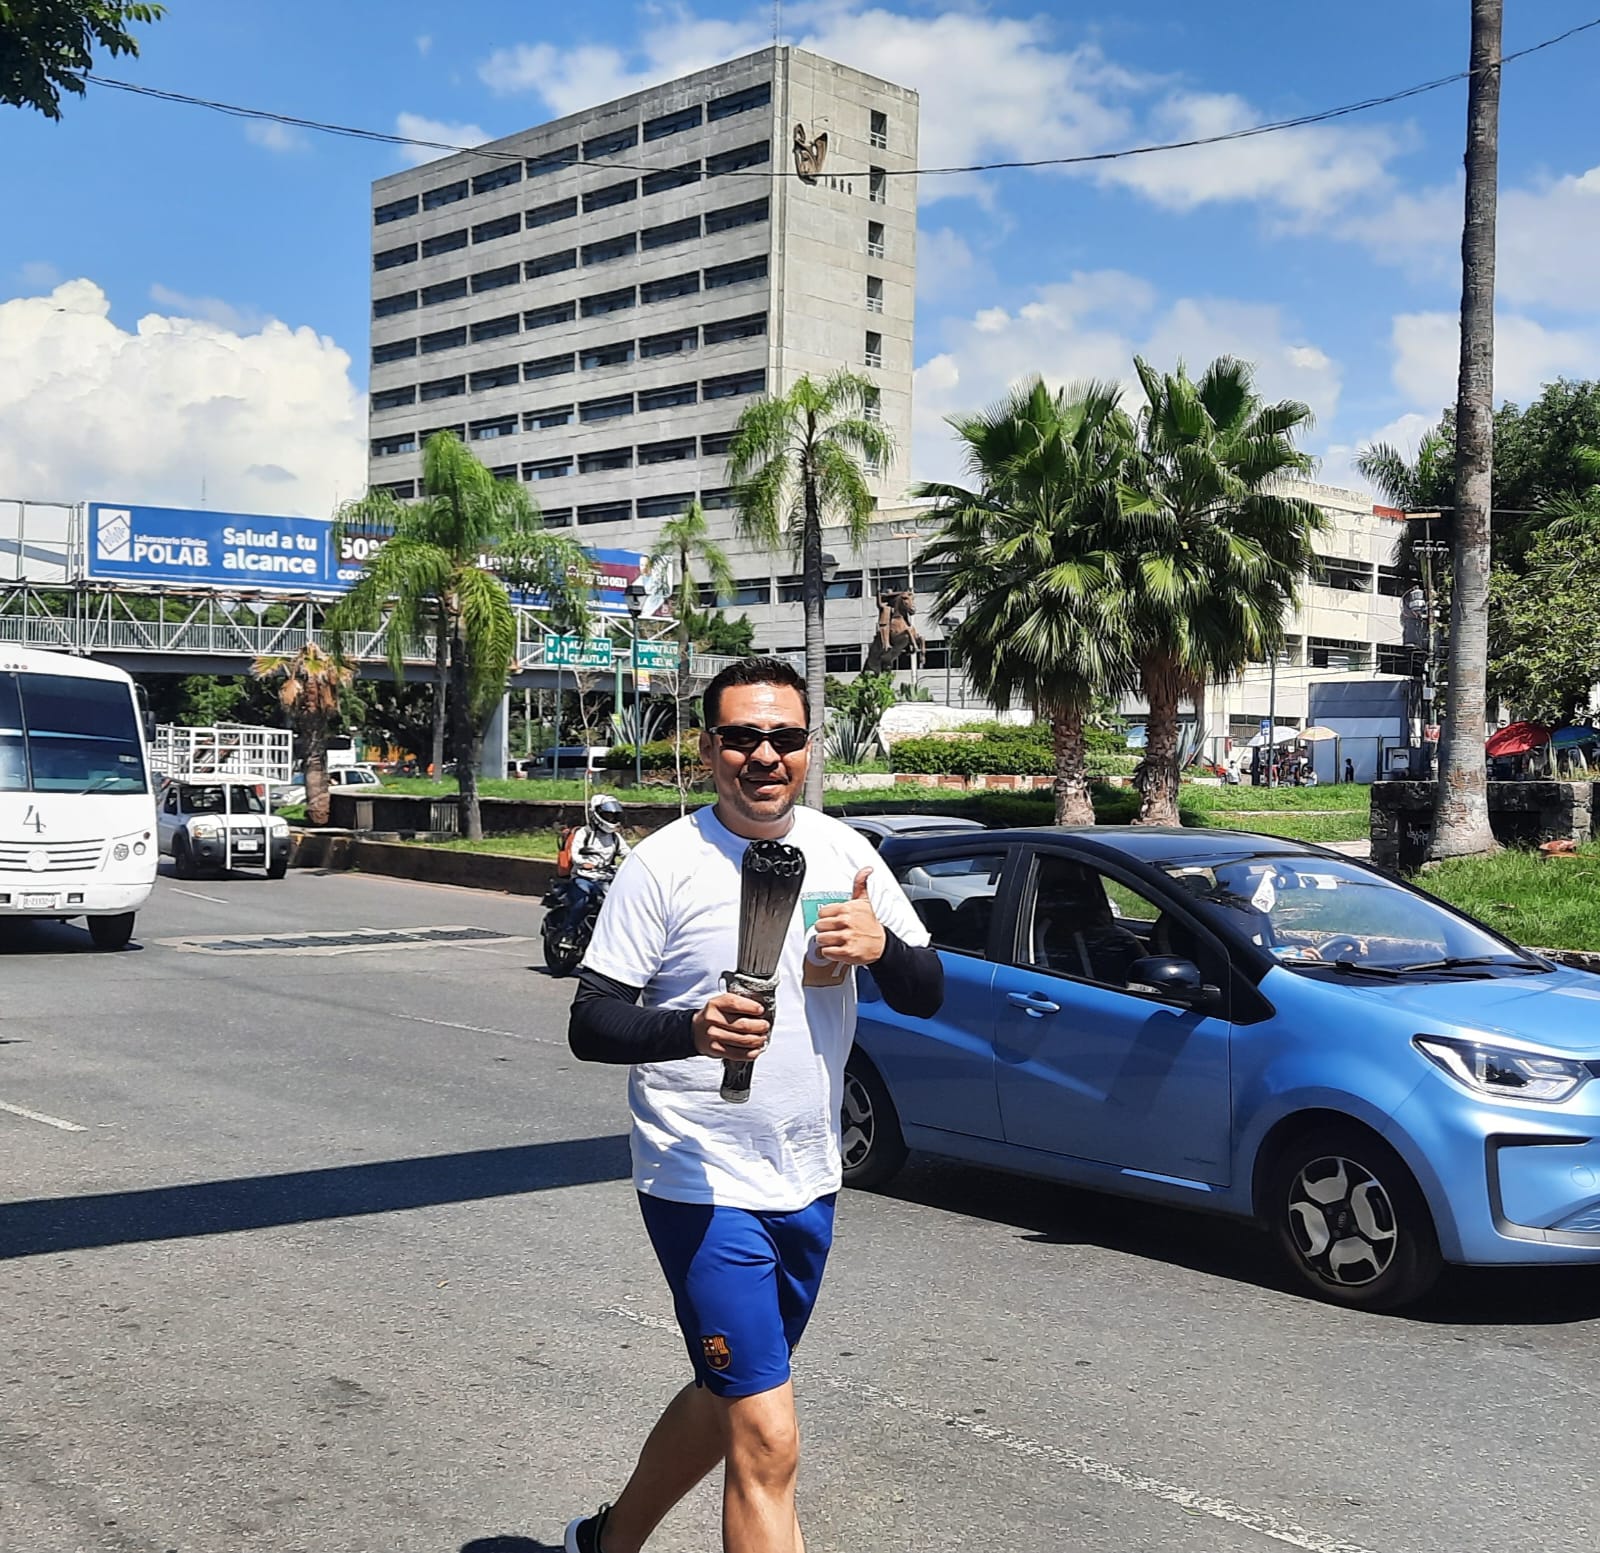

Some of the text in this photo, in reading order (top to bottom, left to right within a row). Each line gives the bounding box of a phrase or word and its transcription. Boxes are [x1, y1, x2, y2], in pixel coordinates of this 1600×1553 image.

[223, 527, 318, 551] Salud a tu
[222, 549, 317, 575] alcance
[638, 656, 648, 665] LA
[23, 805, 46, 833] 4
